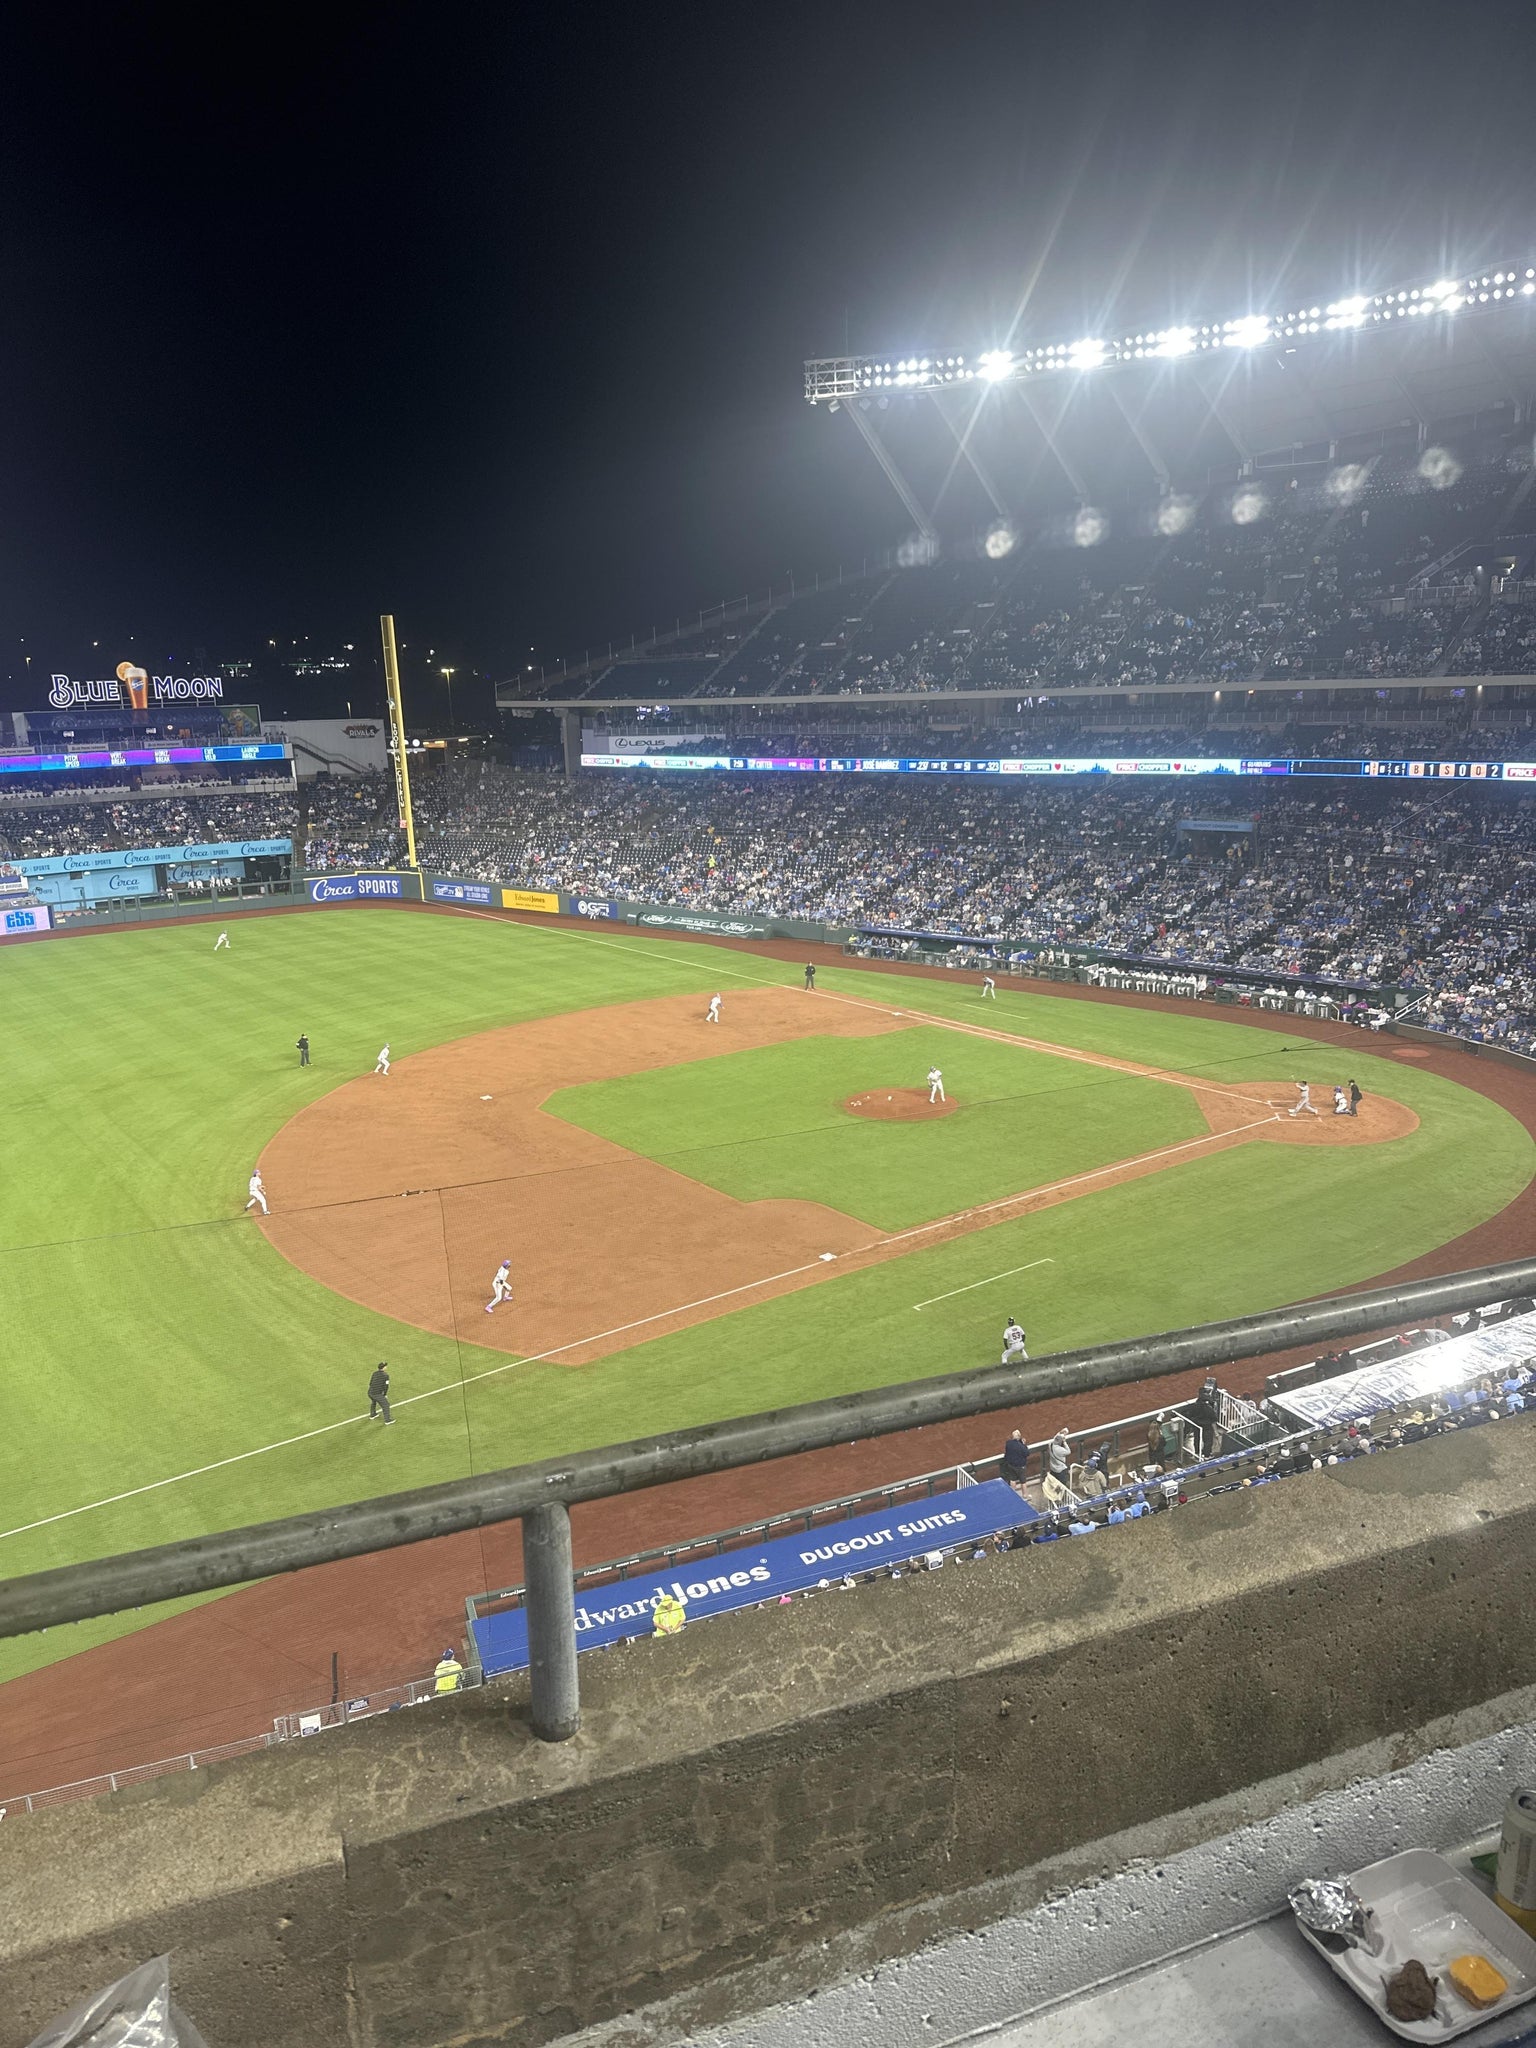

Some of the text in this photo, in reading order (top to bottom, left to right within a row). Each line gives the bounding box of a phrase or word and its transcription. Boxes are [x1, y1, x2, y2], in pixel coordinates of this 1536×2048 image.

[49, 674, 223, 708] BLUE MOON
[1491, 765, 1499, 777] 2
[1508, 768, 1535, 777] PRICE
[183, 847, 209, 860] Circa
[241, 843, 267, 855] Circa
[63, 857, 91, 871] Circa
[124, 852, 151, 865] Circa
[109, 875, 140, 890] Circa
[313, 880, 398, 901] Circa SPORTS
[799, 1509, 967, 1565] DUGOUT SUITES
